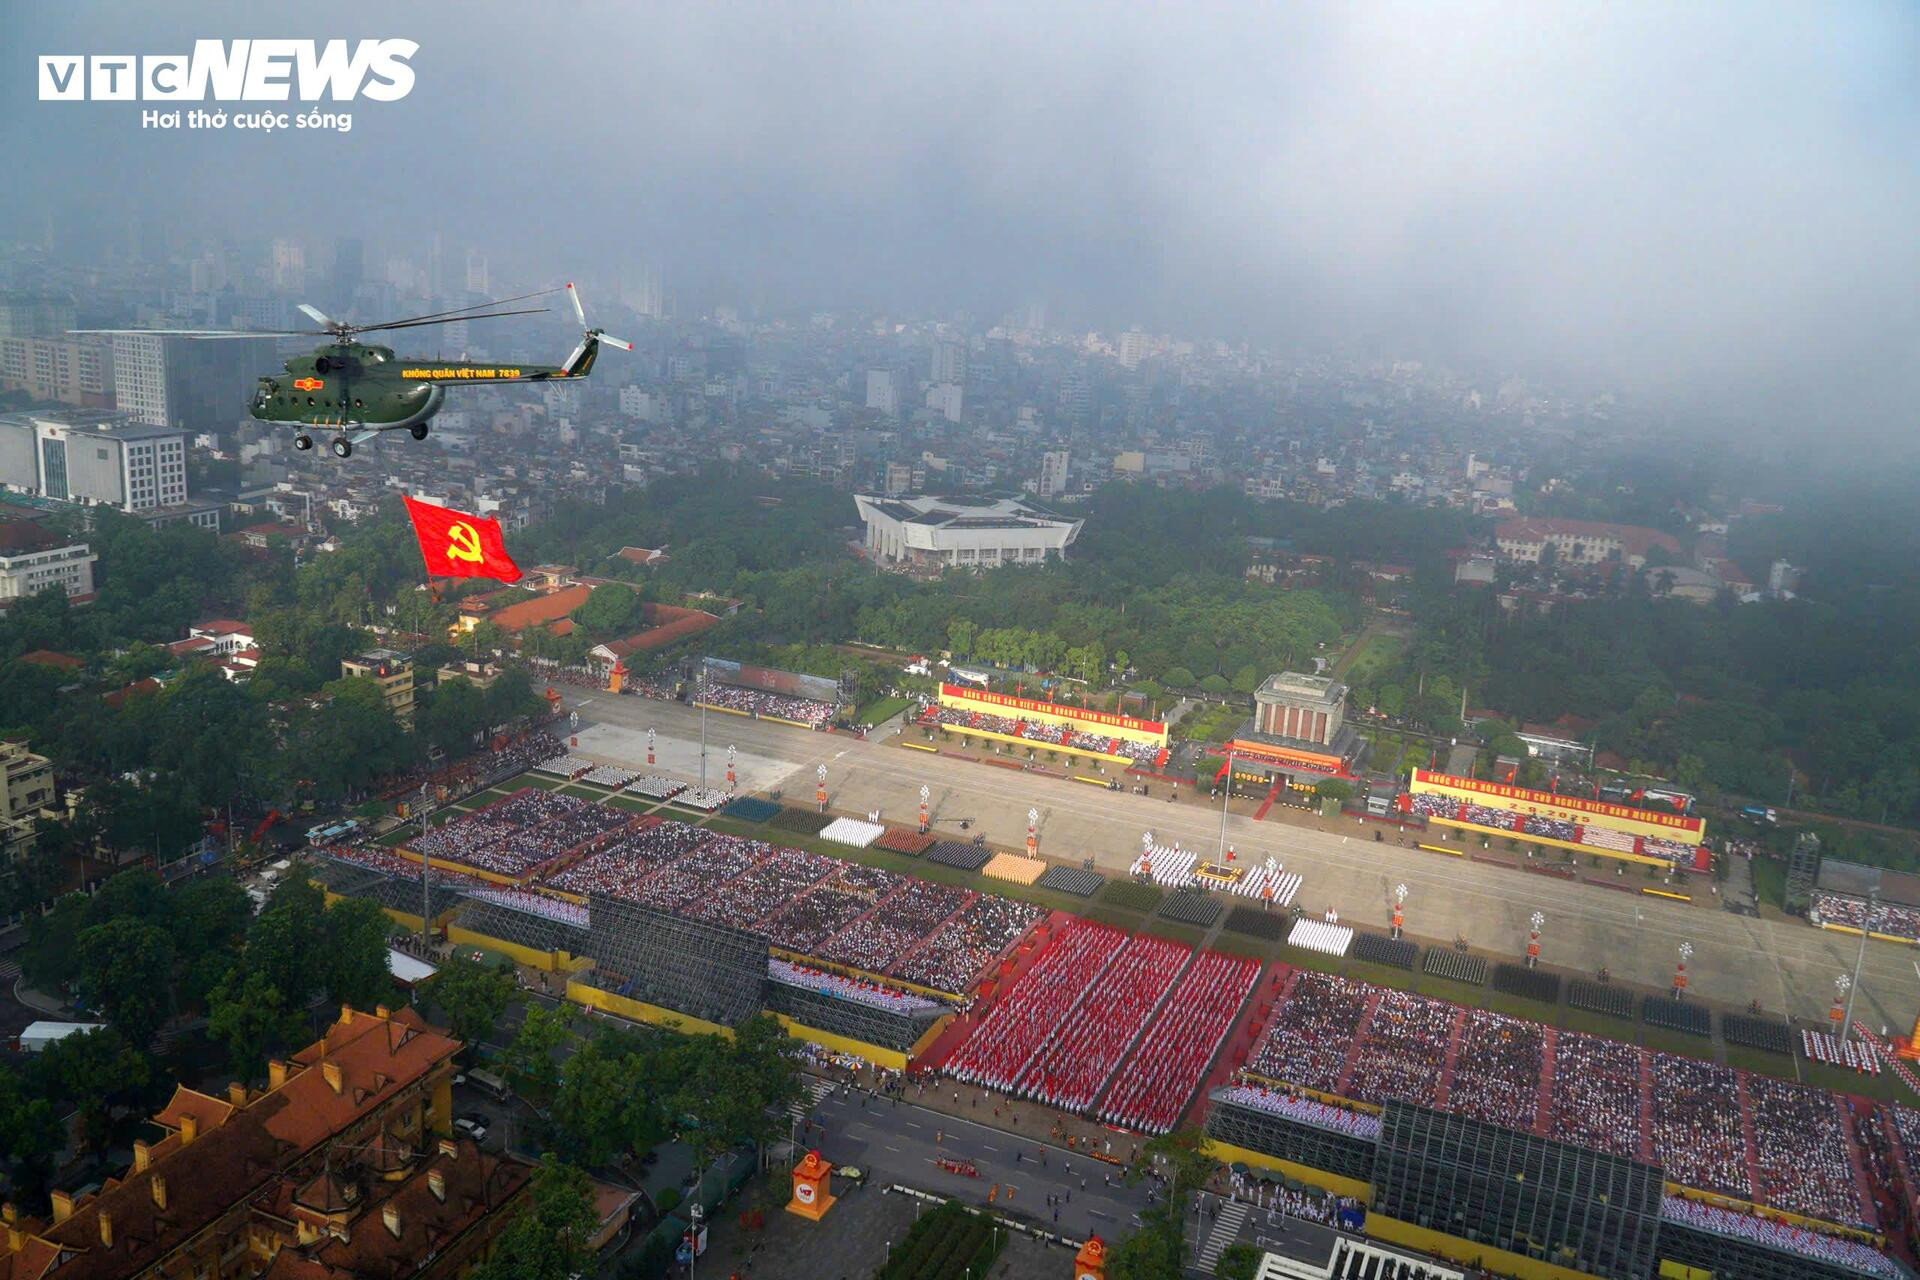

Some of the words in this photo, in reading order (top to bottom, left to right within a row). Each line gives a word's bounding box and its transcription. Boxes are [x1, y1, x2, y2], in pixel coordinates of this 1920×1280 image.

[402, 368, 432, 378] KHÔNG
[432, 368, 456, 379] QUÂN
[456, 367, 474, 379] VIỆT
[475, 369, 495, 378] NAM
[498, 369, 520, 378] 7839
